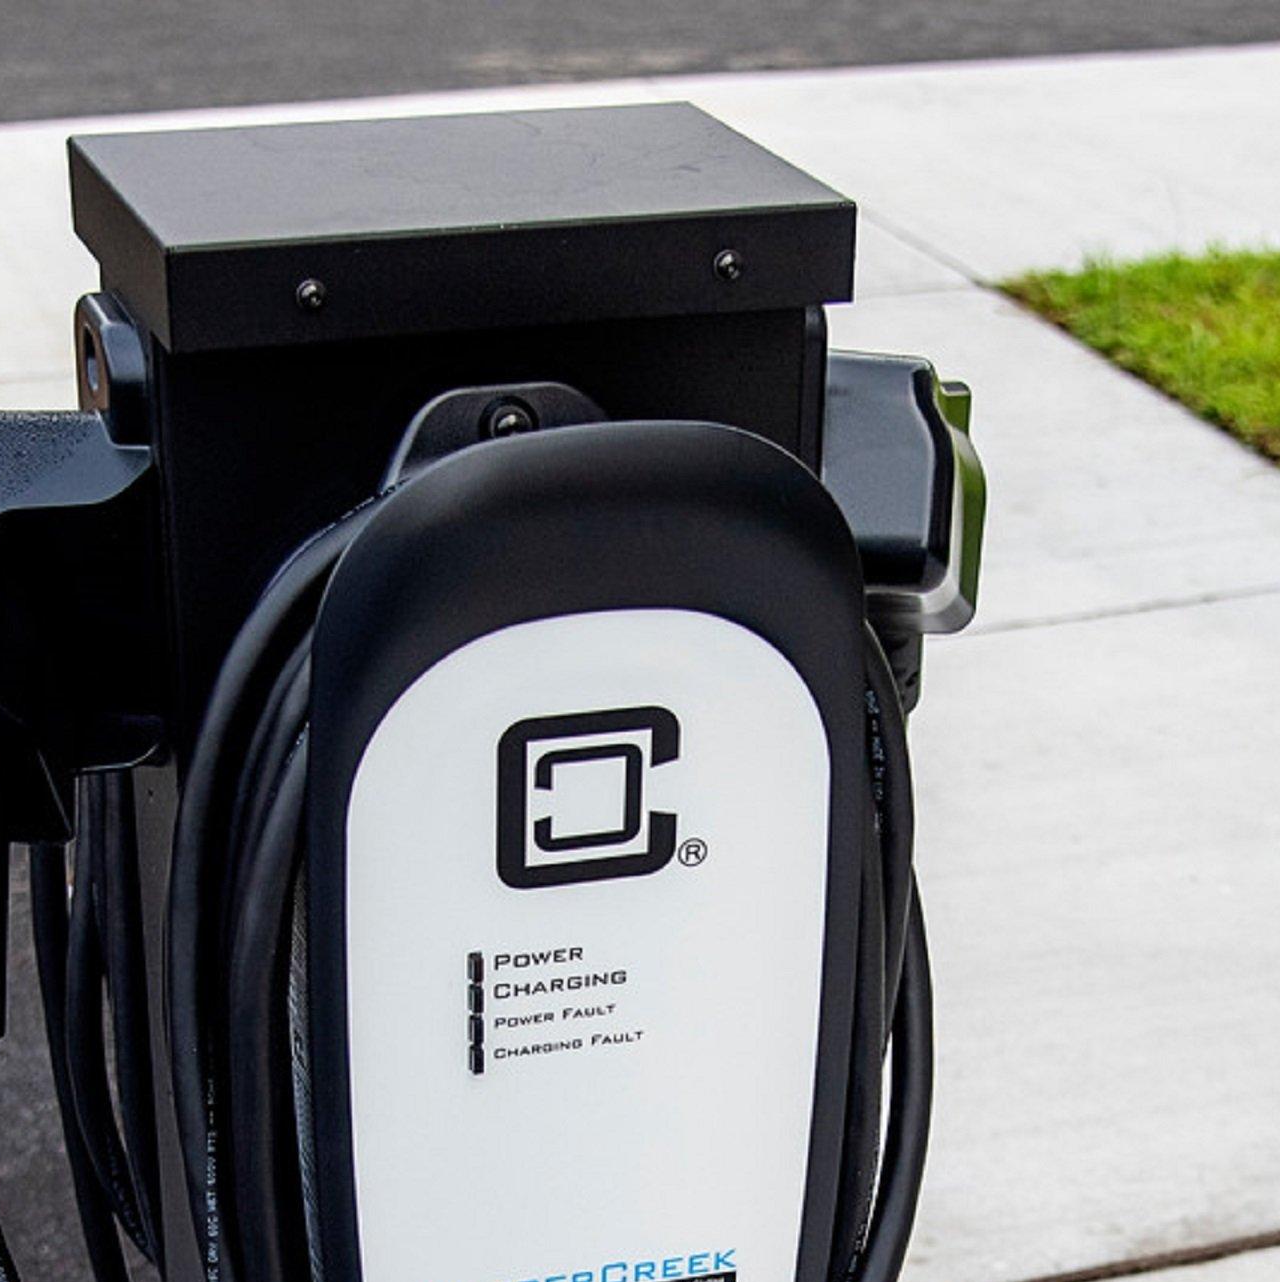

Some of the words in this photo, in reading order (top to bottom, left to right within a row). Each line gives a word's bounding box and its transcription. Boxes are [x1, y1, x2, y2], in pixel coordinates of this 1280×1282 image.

[494, 946, 584, 971] POWER
[493, 969, 628, 1000] CHARGING
[494, 1010, 555, 1029] POWER
[562, 1003, 616, 1021] FAULT
[493, 1037, 584, 1060] CHARGING
[591, 1030, 645, 1046] FAULT
